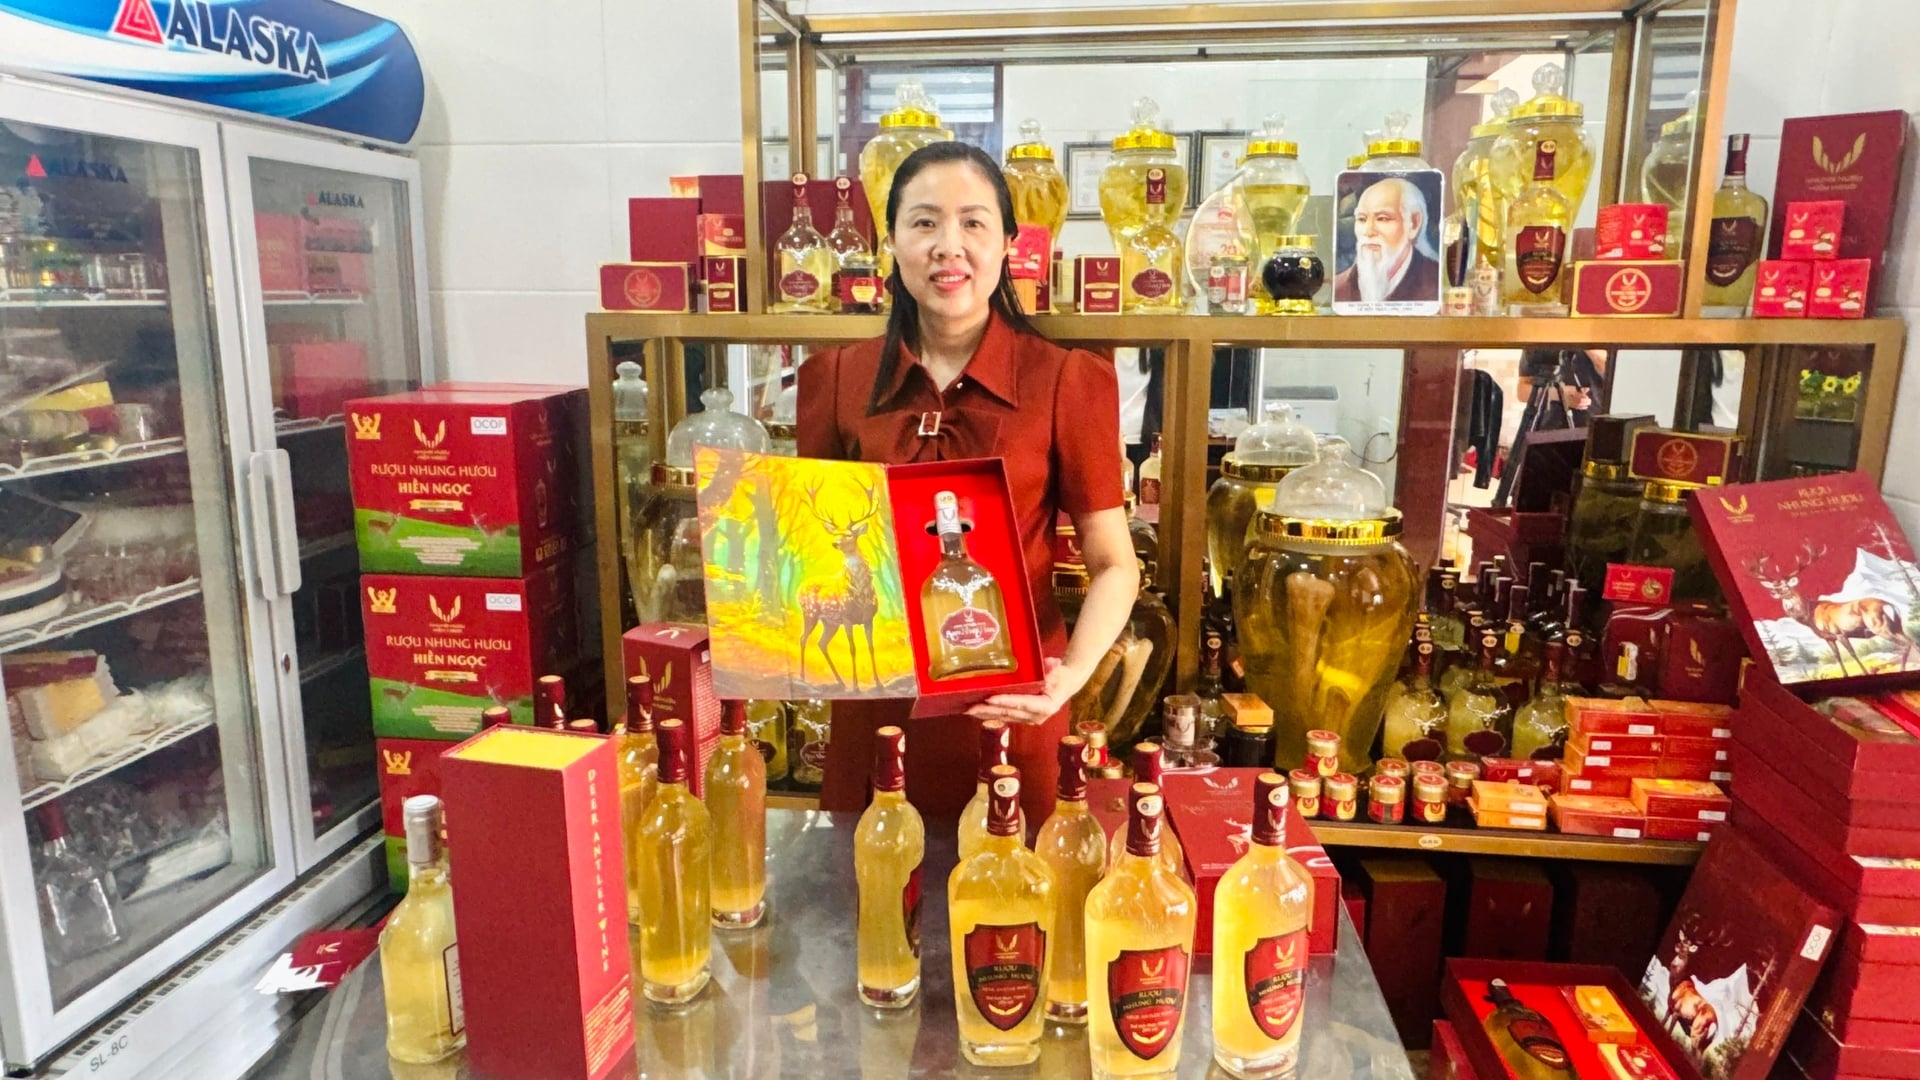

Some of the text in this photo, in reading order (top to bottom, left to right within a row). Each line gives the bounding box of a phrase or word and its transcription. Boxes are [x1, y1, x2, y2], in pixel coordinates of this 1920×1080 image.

[167, 0, 329, 83] ALASKA
[318, 190, 364, 209] ALASKA
[371, 463, 497, 478] RƯỢU NHUNG HƯƠU
[432, 483, 473, 496] NGỌC
[386, 635, 512, 651] RƯỢU NHUNG HƯƠU
[447, 655, 487, 669] NGỌC
[90, 1035, 129, 1072] SL-8C
